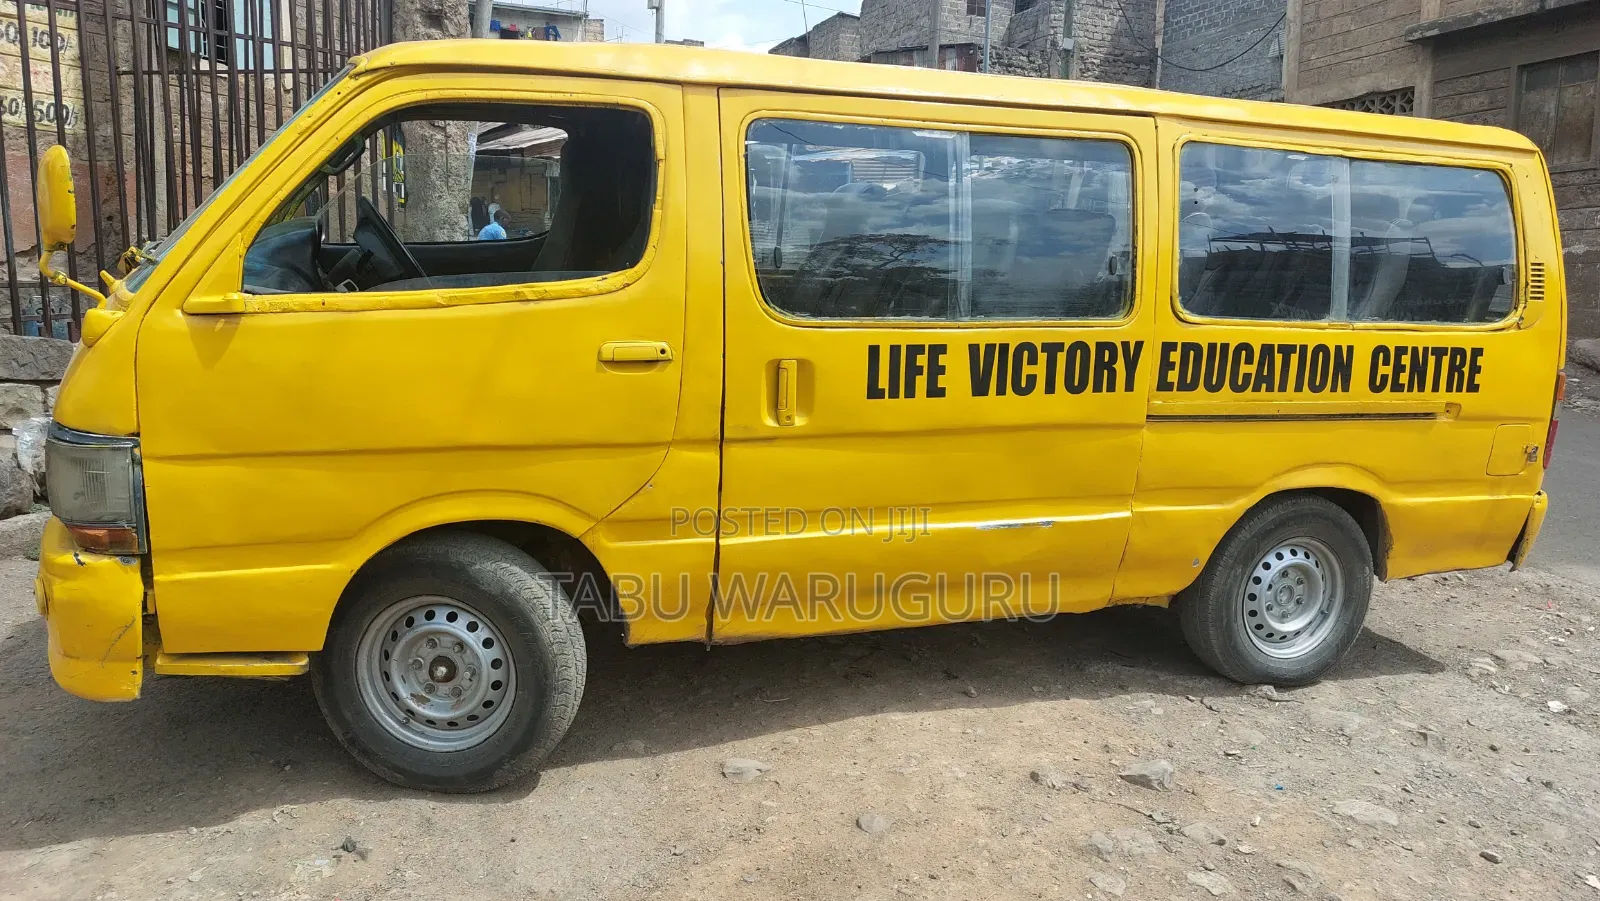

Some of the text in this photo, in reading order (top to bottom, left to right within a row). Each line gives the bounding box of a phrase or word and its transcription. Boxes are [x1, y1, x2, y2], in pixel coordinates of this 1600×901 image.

[867, 341, 1484, 400] LIFE VICTORY EDUCATION CENTRE
